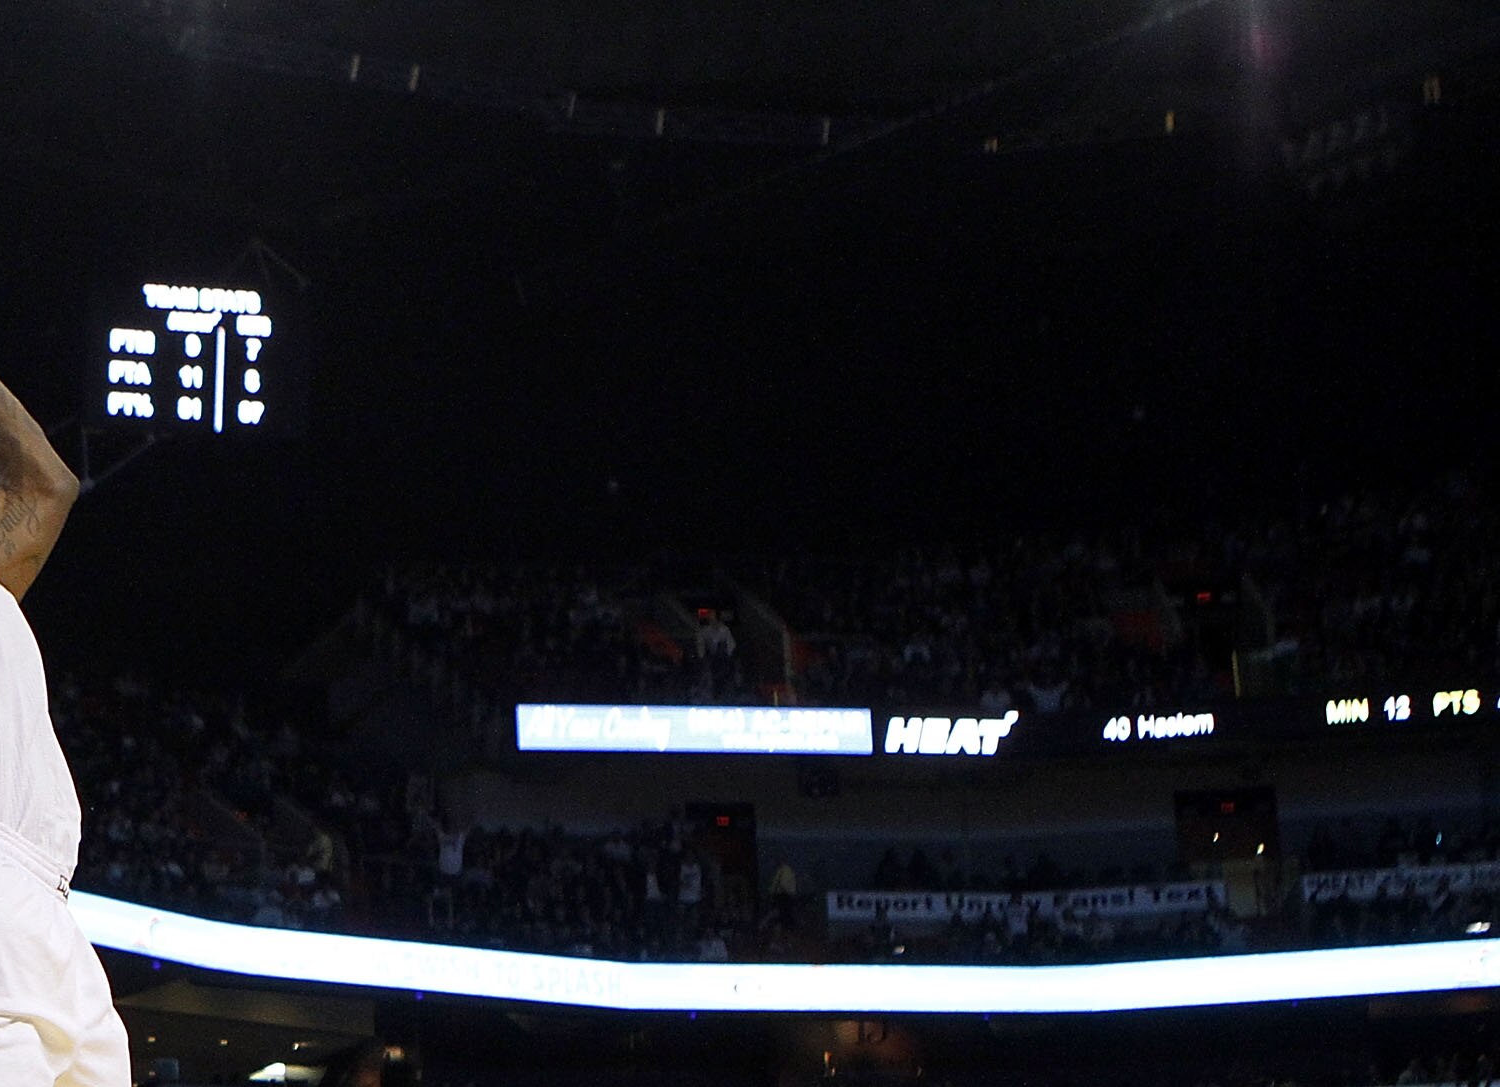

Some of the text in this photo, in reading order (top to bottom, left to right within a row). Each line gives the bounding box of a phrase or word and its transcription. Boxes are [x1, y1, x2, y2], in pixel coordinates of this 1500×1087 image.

[1325, 698, 1369, 725] MIN
[1432, 689, 1481, 717] PTS
[885, 710, 1018, 754] HEAT
[1103, 716, 1131, 741] 40
